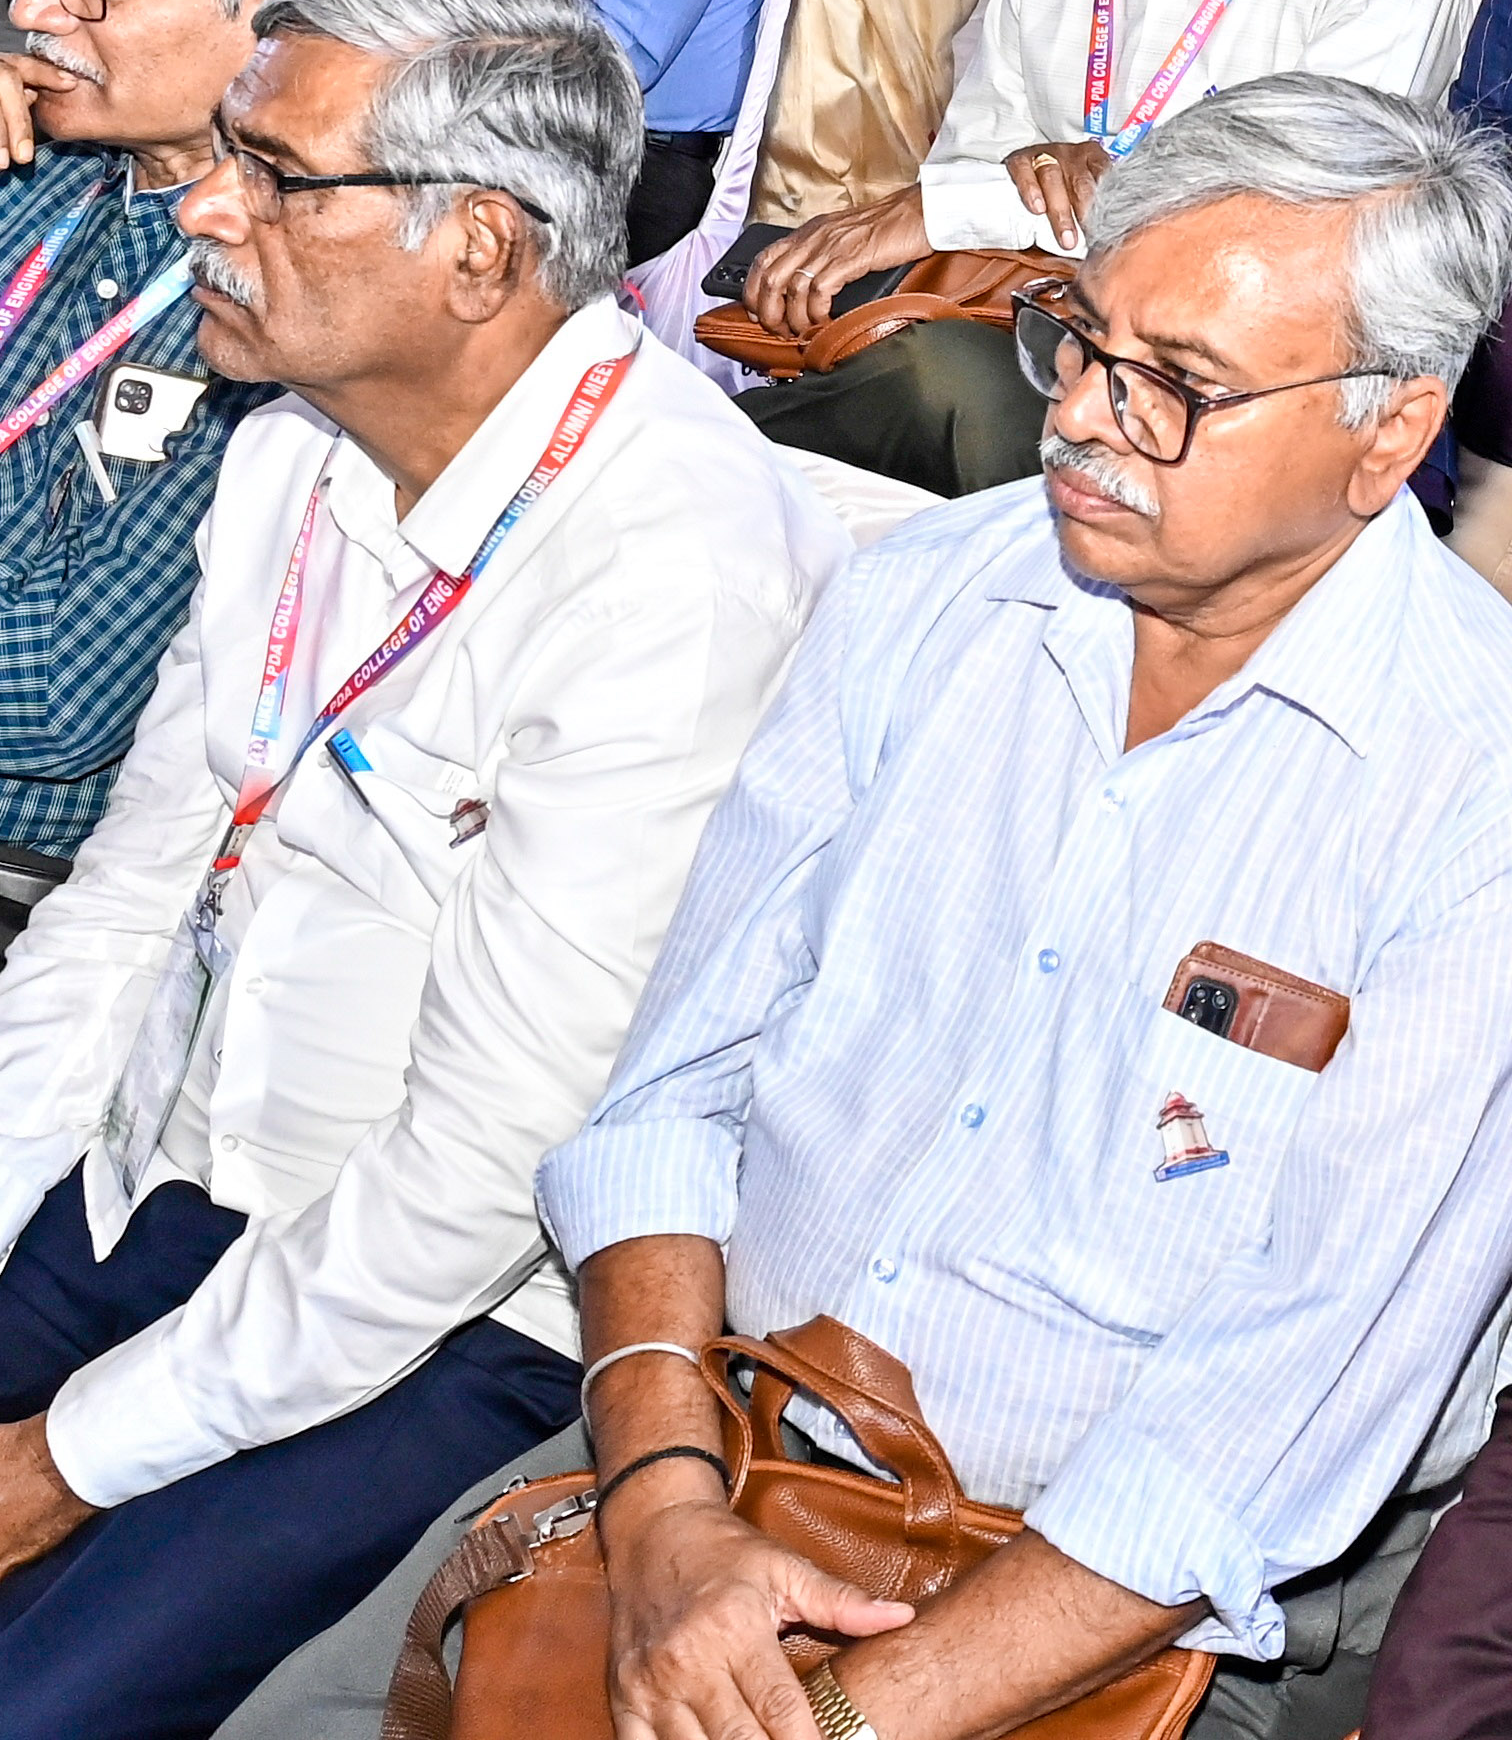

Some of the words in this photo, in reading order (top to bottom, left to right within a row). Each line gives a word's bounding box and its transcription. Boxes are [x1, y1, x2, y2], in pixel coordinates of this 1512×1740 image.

[1095, 8, 1110, 25] OF
[1092, 27, 1110, 78] COLLEGE
[1091, 80, 1105, 106] PDA
[1115, 120, 1142, 154] HKES'
[1137, 97, 1156, 126] PDA
[1153, 46, 1190, 99] COLLEGE
[1184, 30, 1198, 50] OF
[1089, 104, 1104, 134] HKES'
[5, 224, 68, 310] ENGINEERING
[9, 375, 66, 431] COLLEGE
[63, 359, 83, 379] OF
[294, 533, 308, 559] OF
[328, 683, 354, 715] PDA
[353, 626, 410, 688] COLLEGE
[408, 605, 427, 633] OF
[507, 463, 560, 520] GLOBAL
[549, 396, 596, 465] ALUMNI
[273, 561, 300, 637] COLLEGE
[265, 644, 284, 677] PDA
